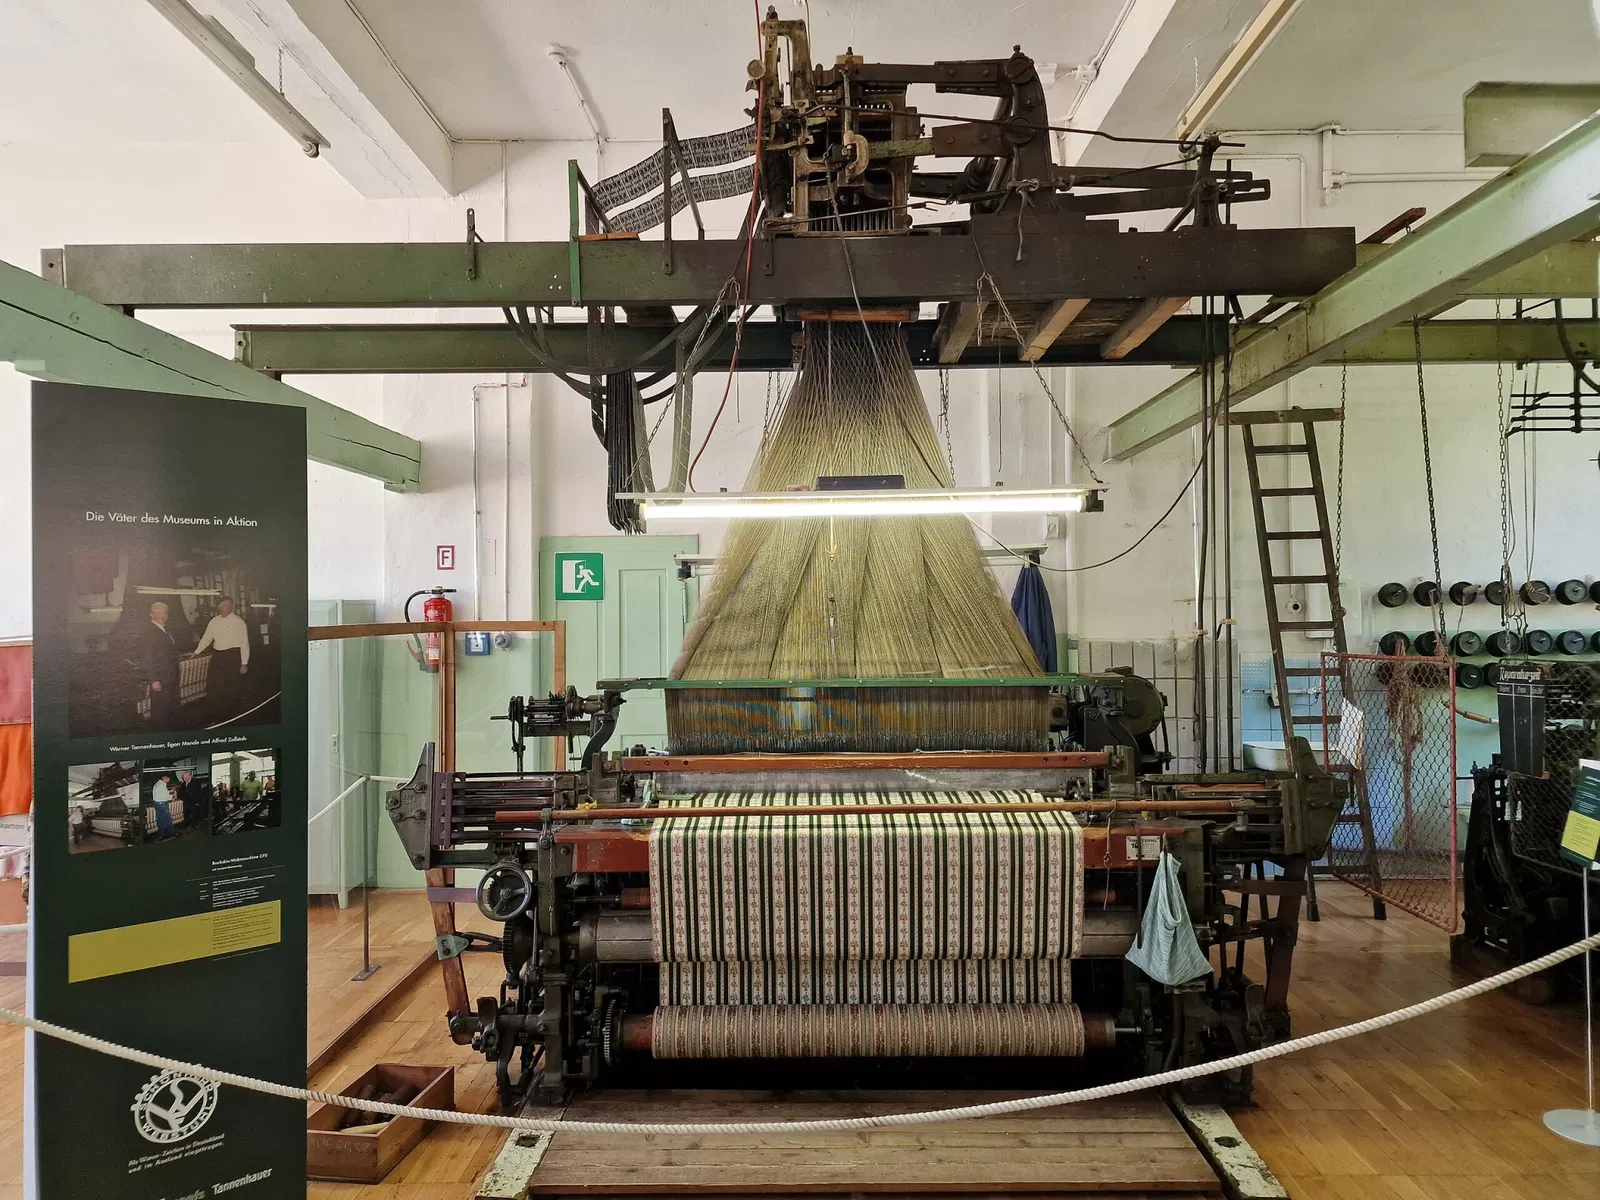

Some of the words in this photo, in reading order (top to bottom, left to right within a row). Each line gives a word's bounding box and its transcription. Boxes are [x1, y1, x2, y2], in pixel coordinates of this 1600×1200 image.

[86, 511, 105, 522] Die
[108, 512, 138, 523] Väter
[141, 512, 160, 524] des
[163, 514, 210, 525] Museums
[213, 516, 223, 526] in
[226, 515, 258, 527] Aktion
[441, 550, 451, 565] F
[167, 741, 180, 749] Egon
[211, 1168, 273, 1195] Tannenhauer
